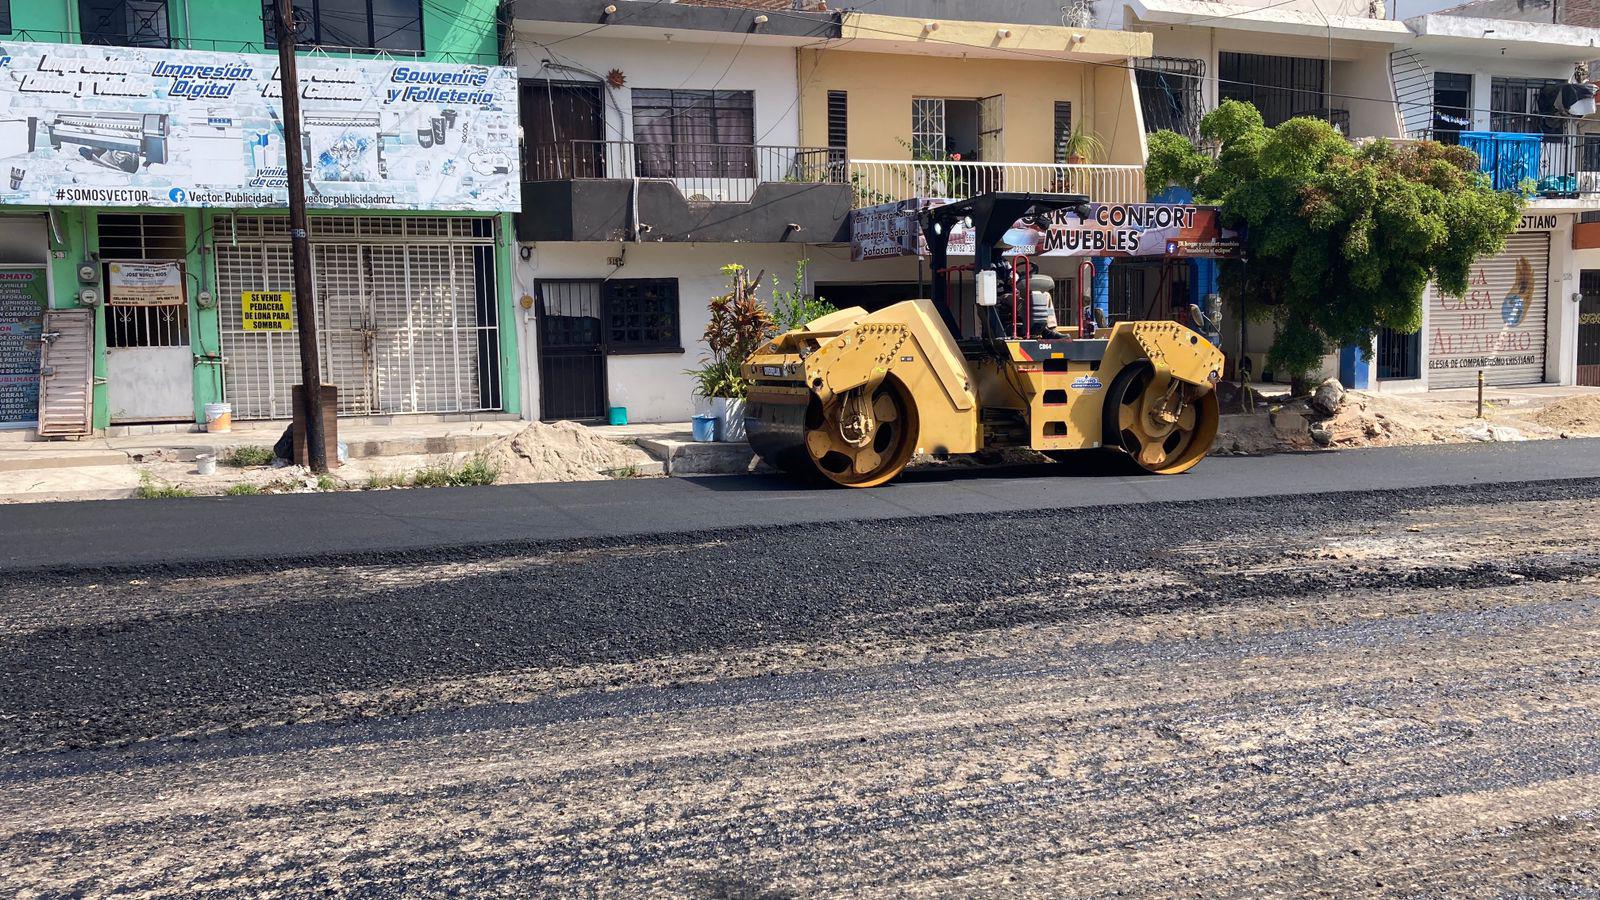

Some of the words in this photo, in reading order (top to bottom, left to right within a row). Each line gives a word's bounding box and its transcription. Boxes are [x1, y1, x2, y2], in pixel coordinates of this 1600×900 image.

[152, 60, 253, 80] Impresión
[391, 67, 488, 87] Souvenirs
[168, 80, 235, 101] Digital
[384, 88, 402, 105] y
[56, 189, 149, 202] #SOMOSVECTOR
[189, 191, 222, 203] Vector
[225, 192, 273, 203] Publicidad
[304, 193, 395, 204] vectorpublicidadmzt
[1095, 204, 1196, 229] CONFORT
[1516, 215, 1557, 229] STIANO
[1042, 228, 1141, 252] MUEBLES
[863, 245, 902, 256] Sofacama
[251, 294, 260, 302] SE
[261, 294, 282, 302] VENDE
[250, 303, 284, 311] PEDACERA
[245, 312, 253, 320] DE
[254, 312, 271, 320] LONA
[272, 312, 290, 320] PARA
[253, 321, 282, 329] SOMBRA
[1450, 359, 1459, 368] DE
